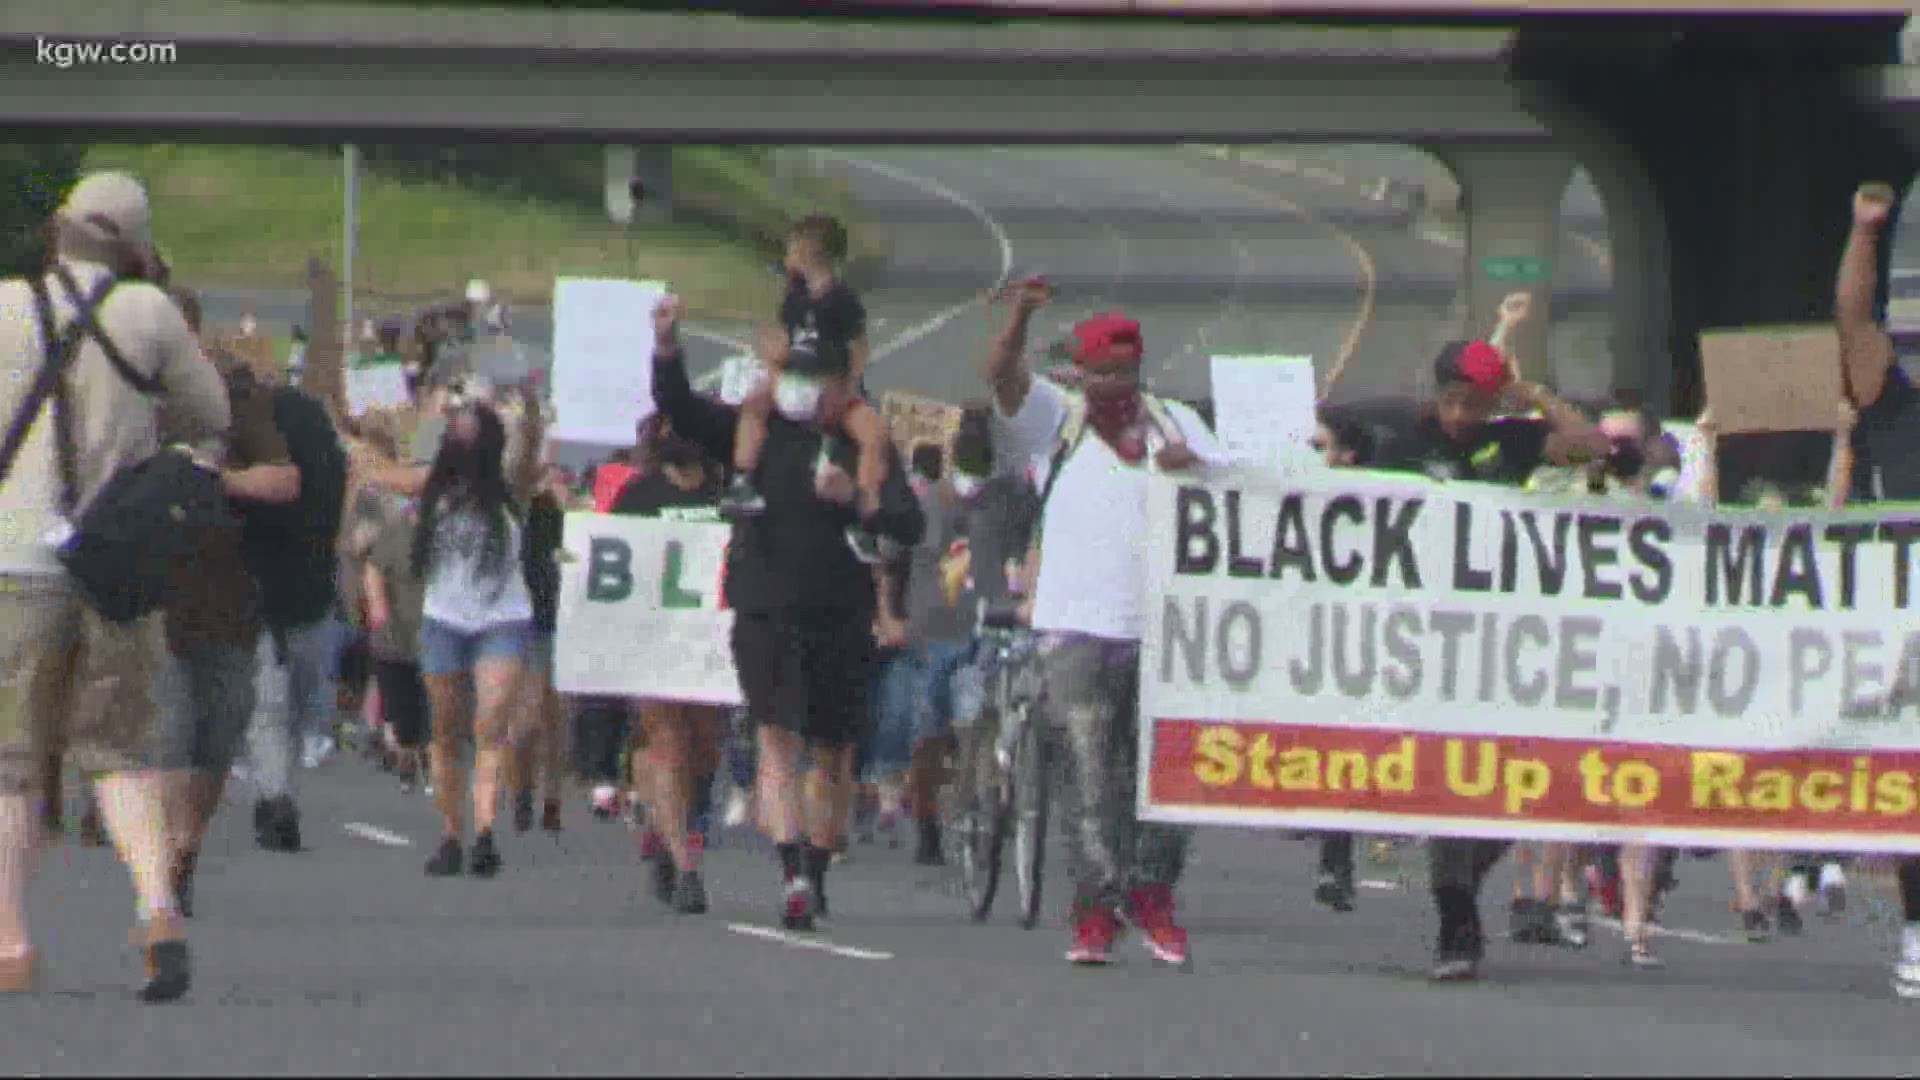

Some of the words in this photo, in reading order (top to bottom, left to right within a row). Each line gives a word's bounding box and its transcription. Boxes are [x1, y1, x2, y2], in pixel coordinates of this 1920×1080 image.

[587, 537, 731, 612] BL
[1174, 486, 1424, 588] BLACK
[1453, 501, 1673, 604] LIVES
[1704, 520, 1920, 609] MATT
[1159, 595, 1261, 690] NO
[1289, 603, 1622, 733] JUSTICE,
[1649, 624, 1761, 718] NO
[1193, 726, 1416, 792] Stand
[1445, 739, 1551, 813] Up
[1579, 750, 1661, 807] to
[1691, 752, 1920, 813] Racis
